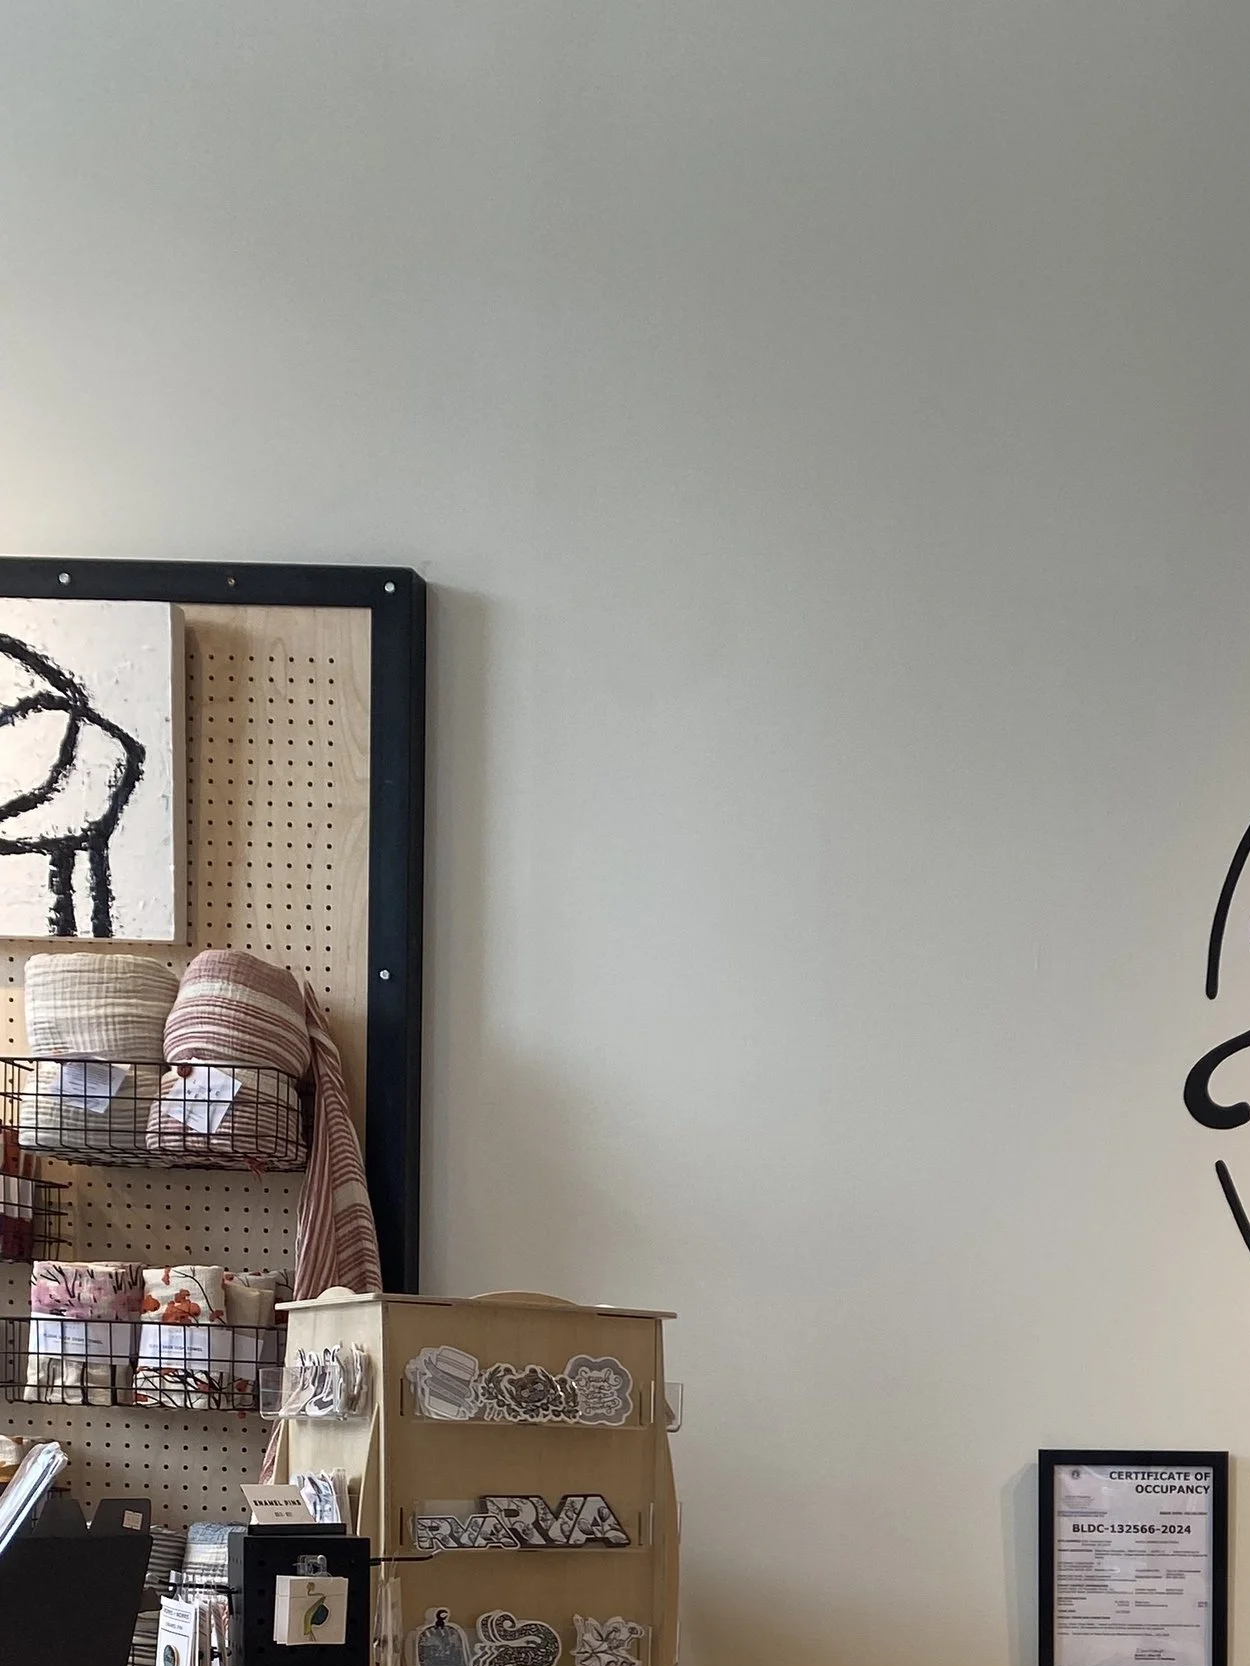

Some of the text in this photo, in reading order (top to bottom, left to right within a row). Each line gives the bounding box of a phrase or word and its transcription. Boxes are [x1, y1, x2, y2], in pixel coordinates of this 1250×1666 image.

[1109, 1471, 1211, 1482] CERTIFICATE OF
[1135, 1484, 1211, 1495] OCCUPANCY
[481, 1495, 631, 1547] RVA
[417, 1516, 518, 1549] RVA
[1072, 1524, 1191, 1535] BLDC-132566-2024
